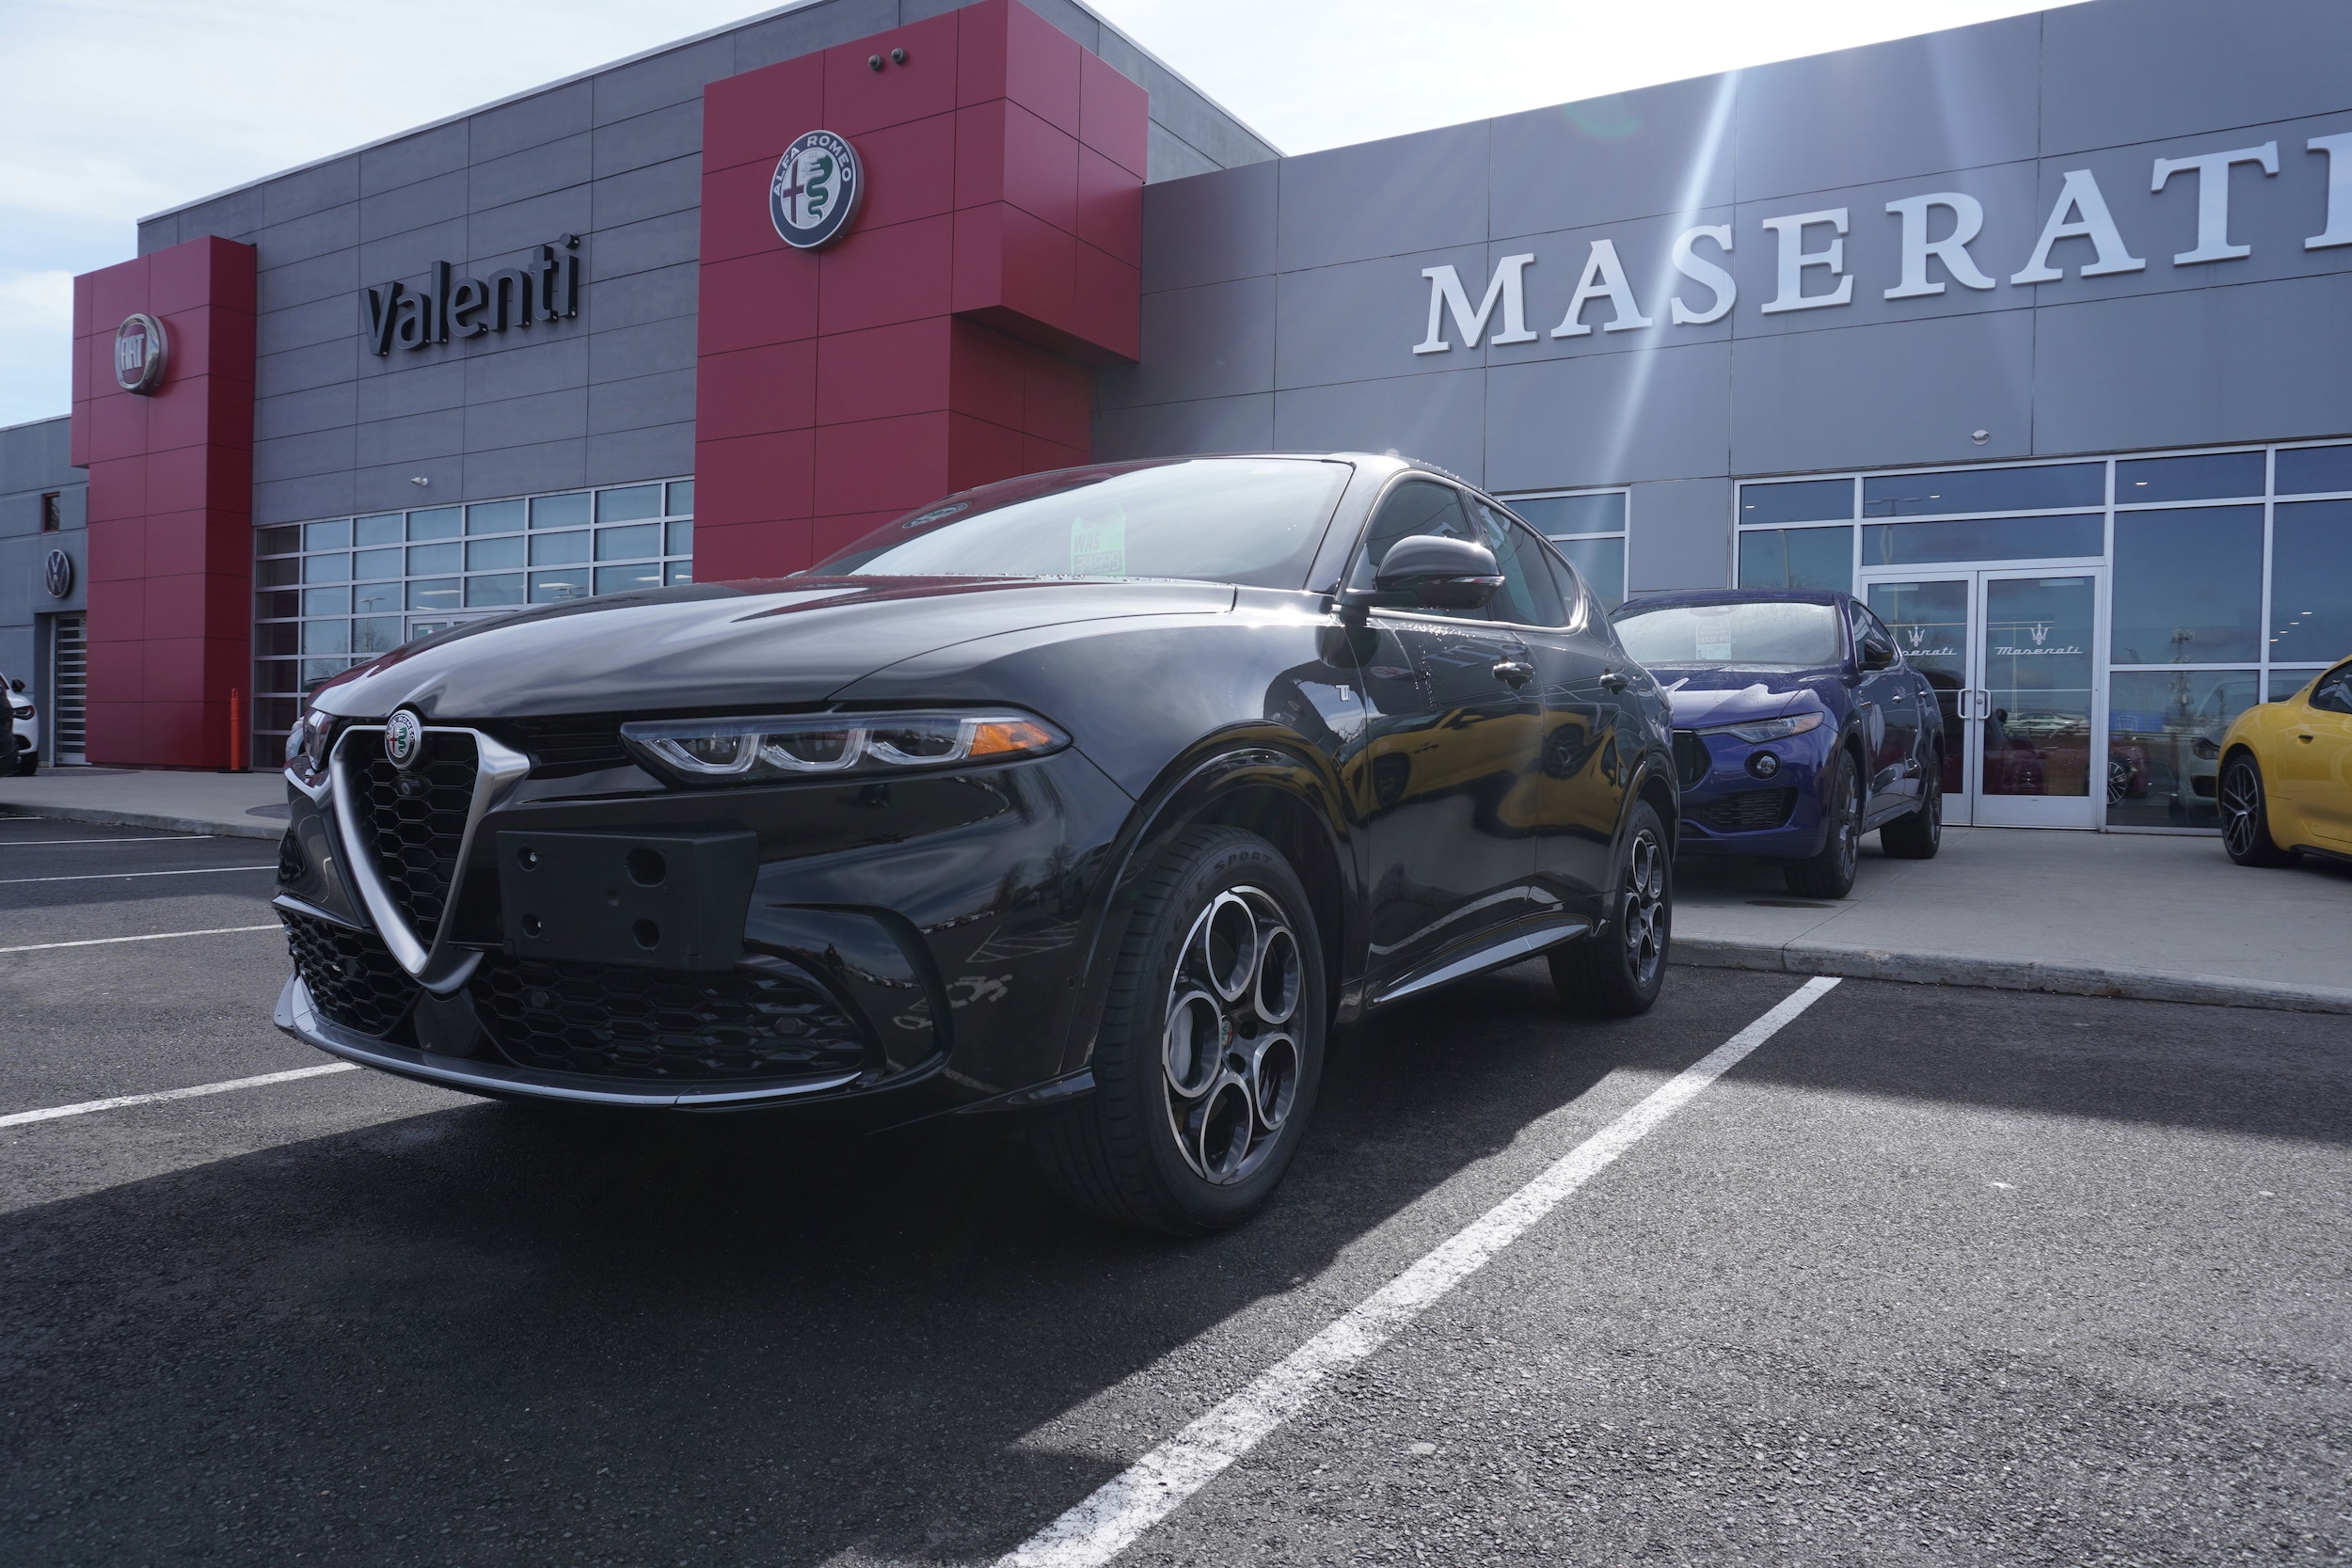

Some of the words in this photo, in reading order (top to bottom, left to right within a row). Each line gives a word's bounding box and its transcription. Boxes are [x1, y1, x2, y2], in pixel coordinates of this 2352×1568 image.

[772, 147, 800, 196] ALFA
[806, 135, 852, 182] ROMEO
[1412, 132, 2352, 355] MASERATI
[360, 232, 580, 357] Valenti
[121, 334, 144, 372] FIAT
[1074, 531, 1101, 553] WAS
[1902, 646, 1958, 656] serati
[1994, 645, 2084, 656] Maserati
[398, 717, 415, 740] ROMEO
[1214, 851, 1273, 873] SPORT
